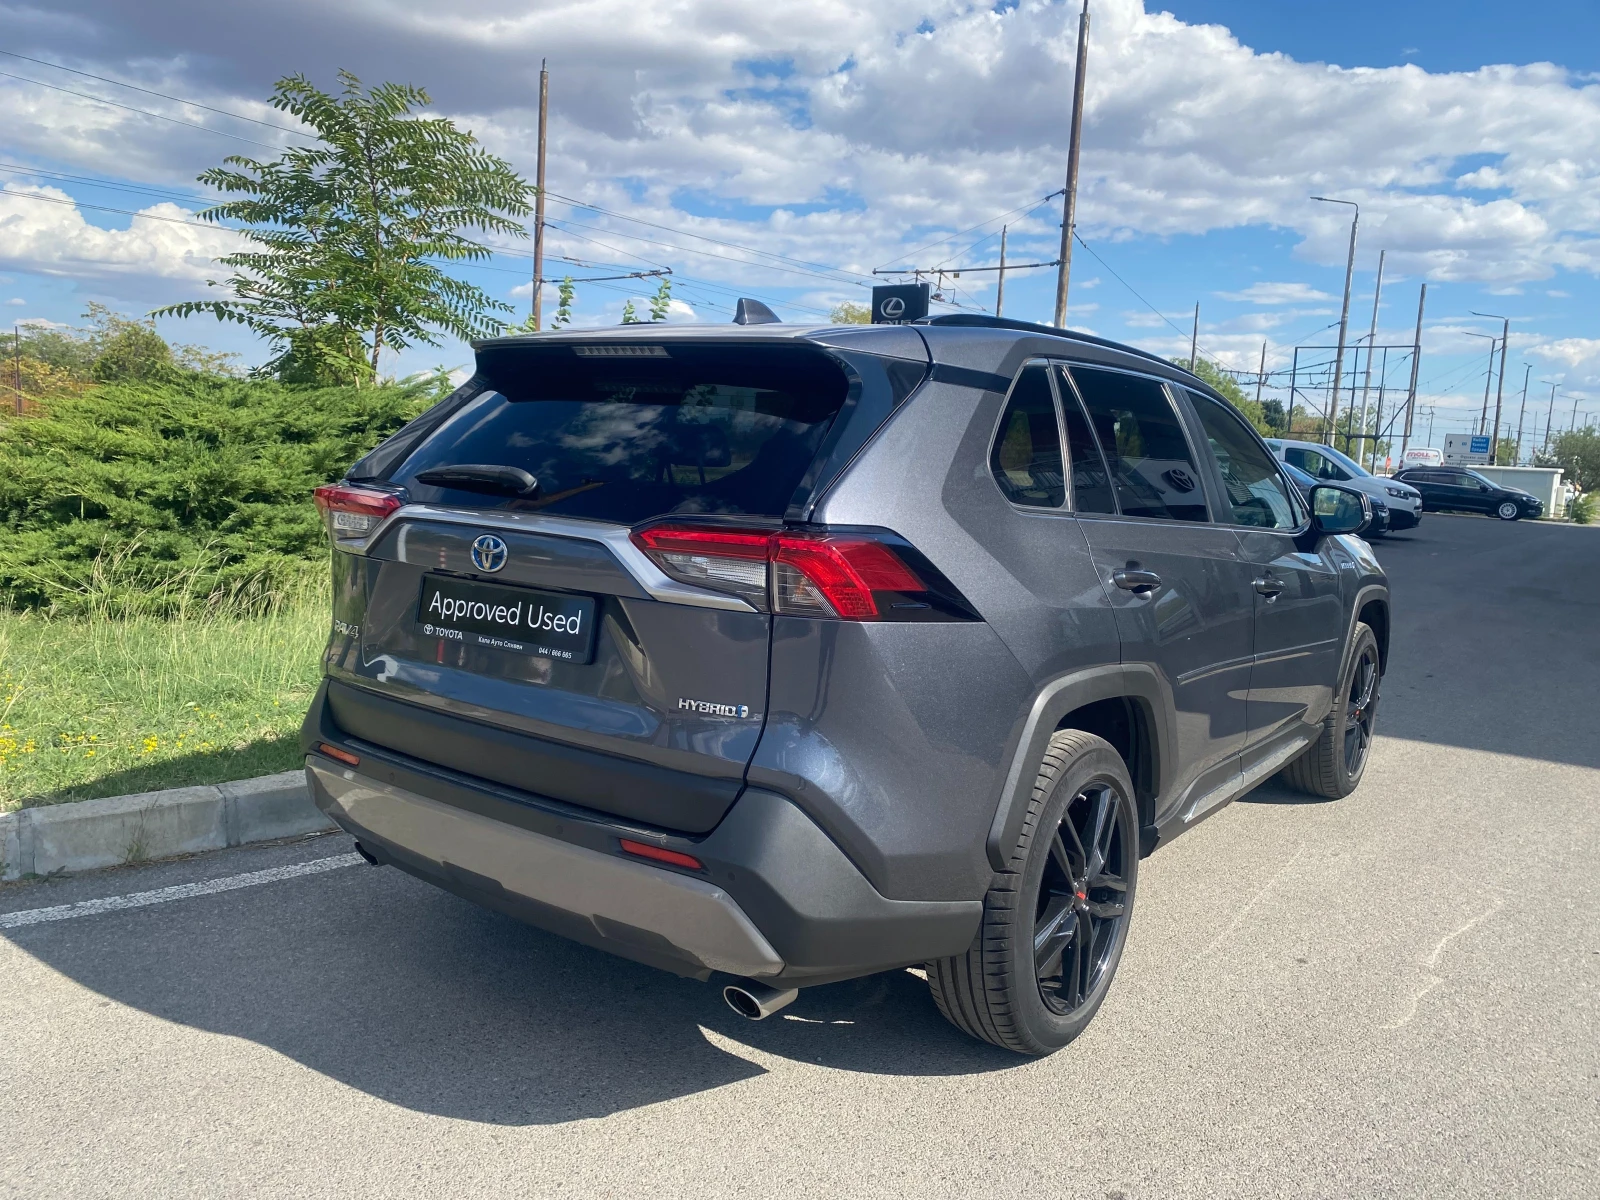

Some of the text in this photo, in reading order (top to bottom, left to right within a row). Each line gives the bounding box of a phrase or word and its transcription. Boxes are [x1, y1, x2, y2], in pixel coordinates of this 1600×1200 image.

[428, 590, 582, 635] Approved Used
[335, 620, 359, 639] RAV4
[435, 627, 463, 640] TOYOTA
[538, 647, 548, 655] 044
[678, 698, 737, 717] HYBRID
